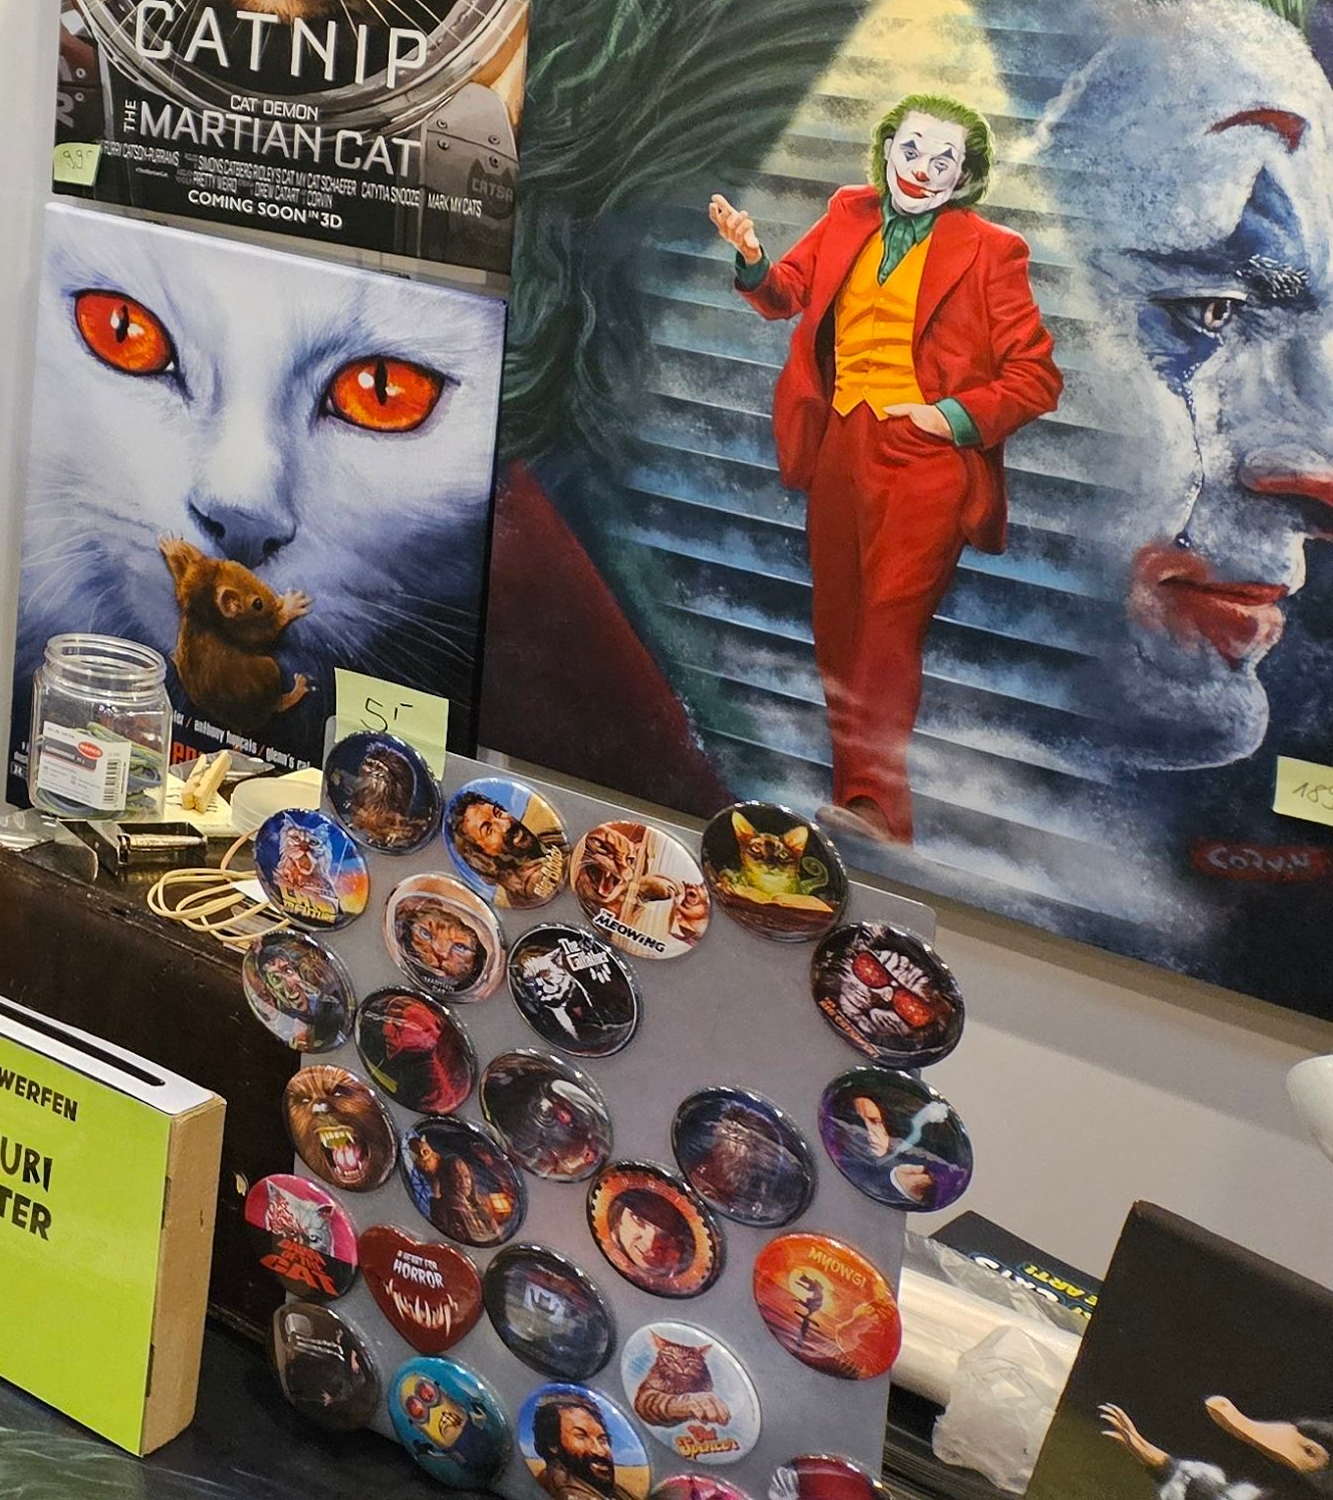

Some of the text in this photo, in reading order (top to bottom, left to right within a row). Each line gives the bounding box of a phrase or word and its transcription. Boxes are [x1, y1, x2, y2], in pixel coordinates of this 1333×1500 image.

[135, 0, 429, 88] CATNIP
[123, 99, 137, 133] THE
[230, 95, 319, 121] CAT DEMON
[139, 101, 422, 177] MARTIAN CAT
[188, 190, 254, 215] COMING
[258, 202, 308, 224] SOON
[321, 213, 343, 229] 3D
[393, 1258, 445, 1288] HORROR
